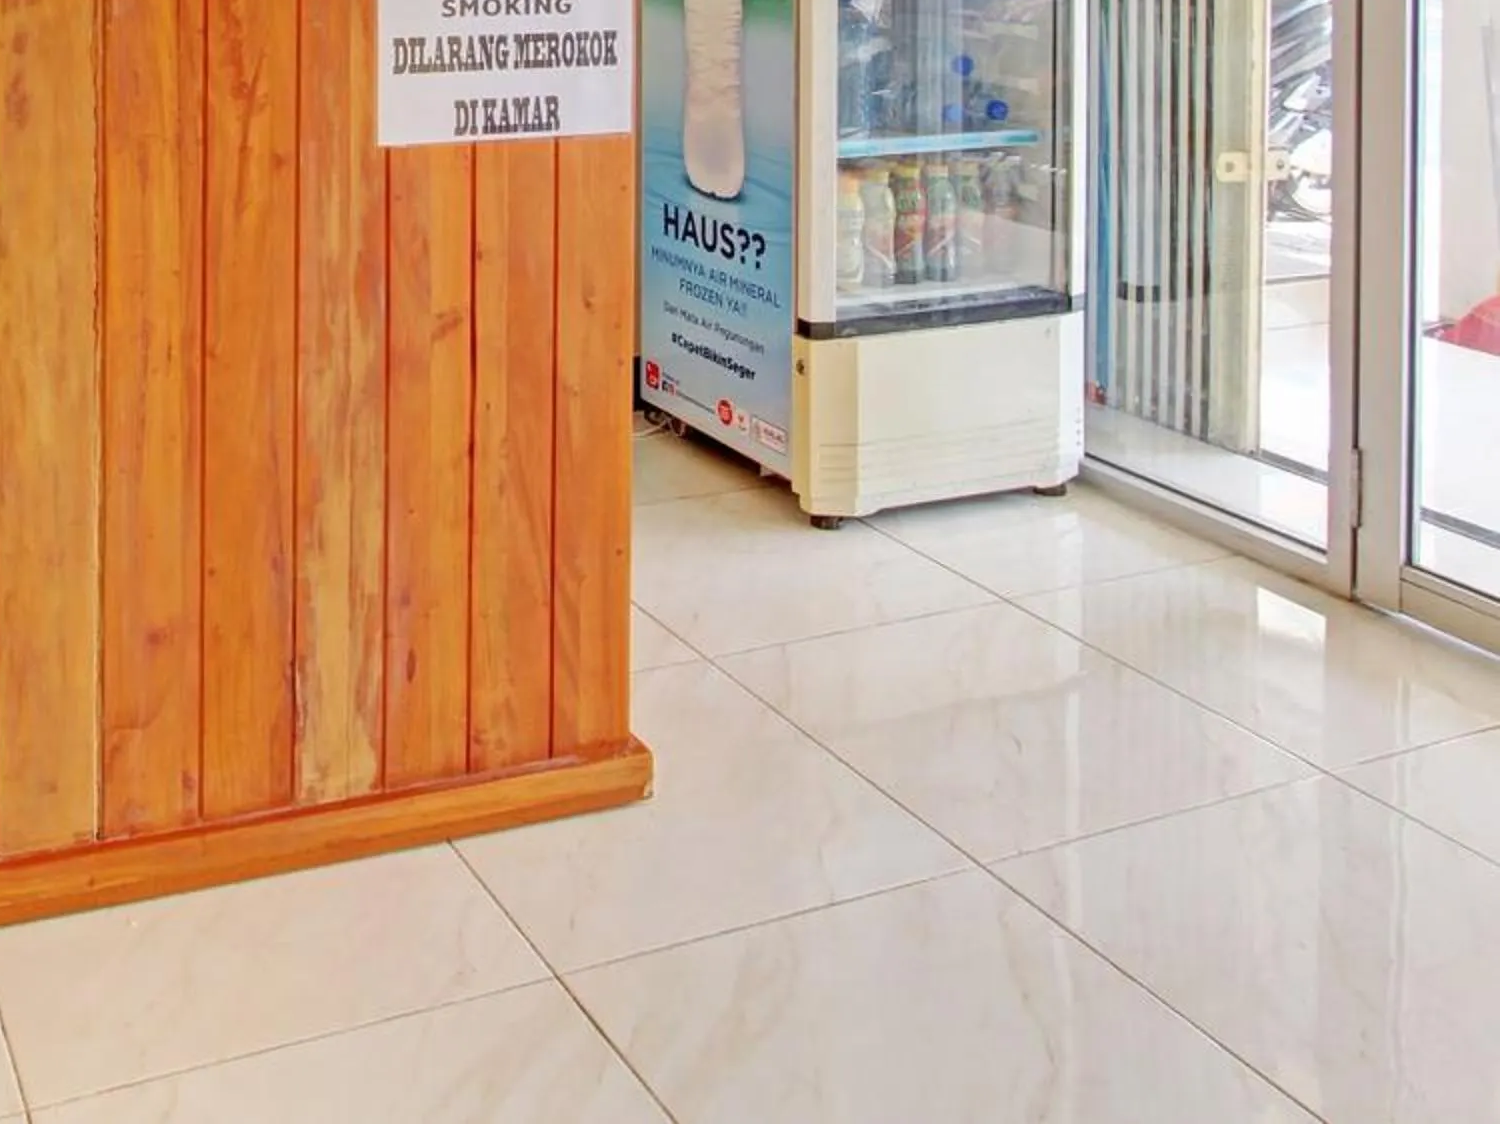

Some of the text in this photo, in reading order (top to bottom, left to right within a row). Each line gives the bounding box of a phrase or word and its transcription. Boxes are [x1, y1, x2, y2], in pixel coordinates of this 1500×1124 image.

[392, 29, 618, 75] DILARANG MEROKOK
[453, 95, 561, 136] DI KAMAR
[663, 202, 767, 270] HAUS??
[679, 277, 724, 309] FROZEN
[707, 267, 728, 288] AIR
[729, 274, 782, 310] MINERAL
